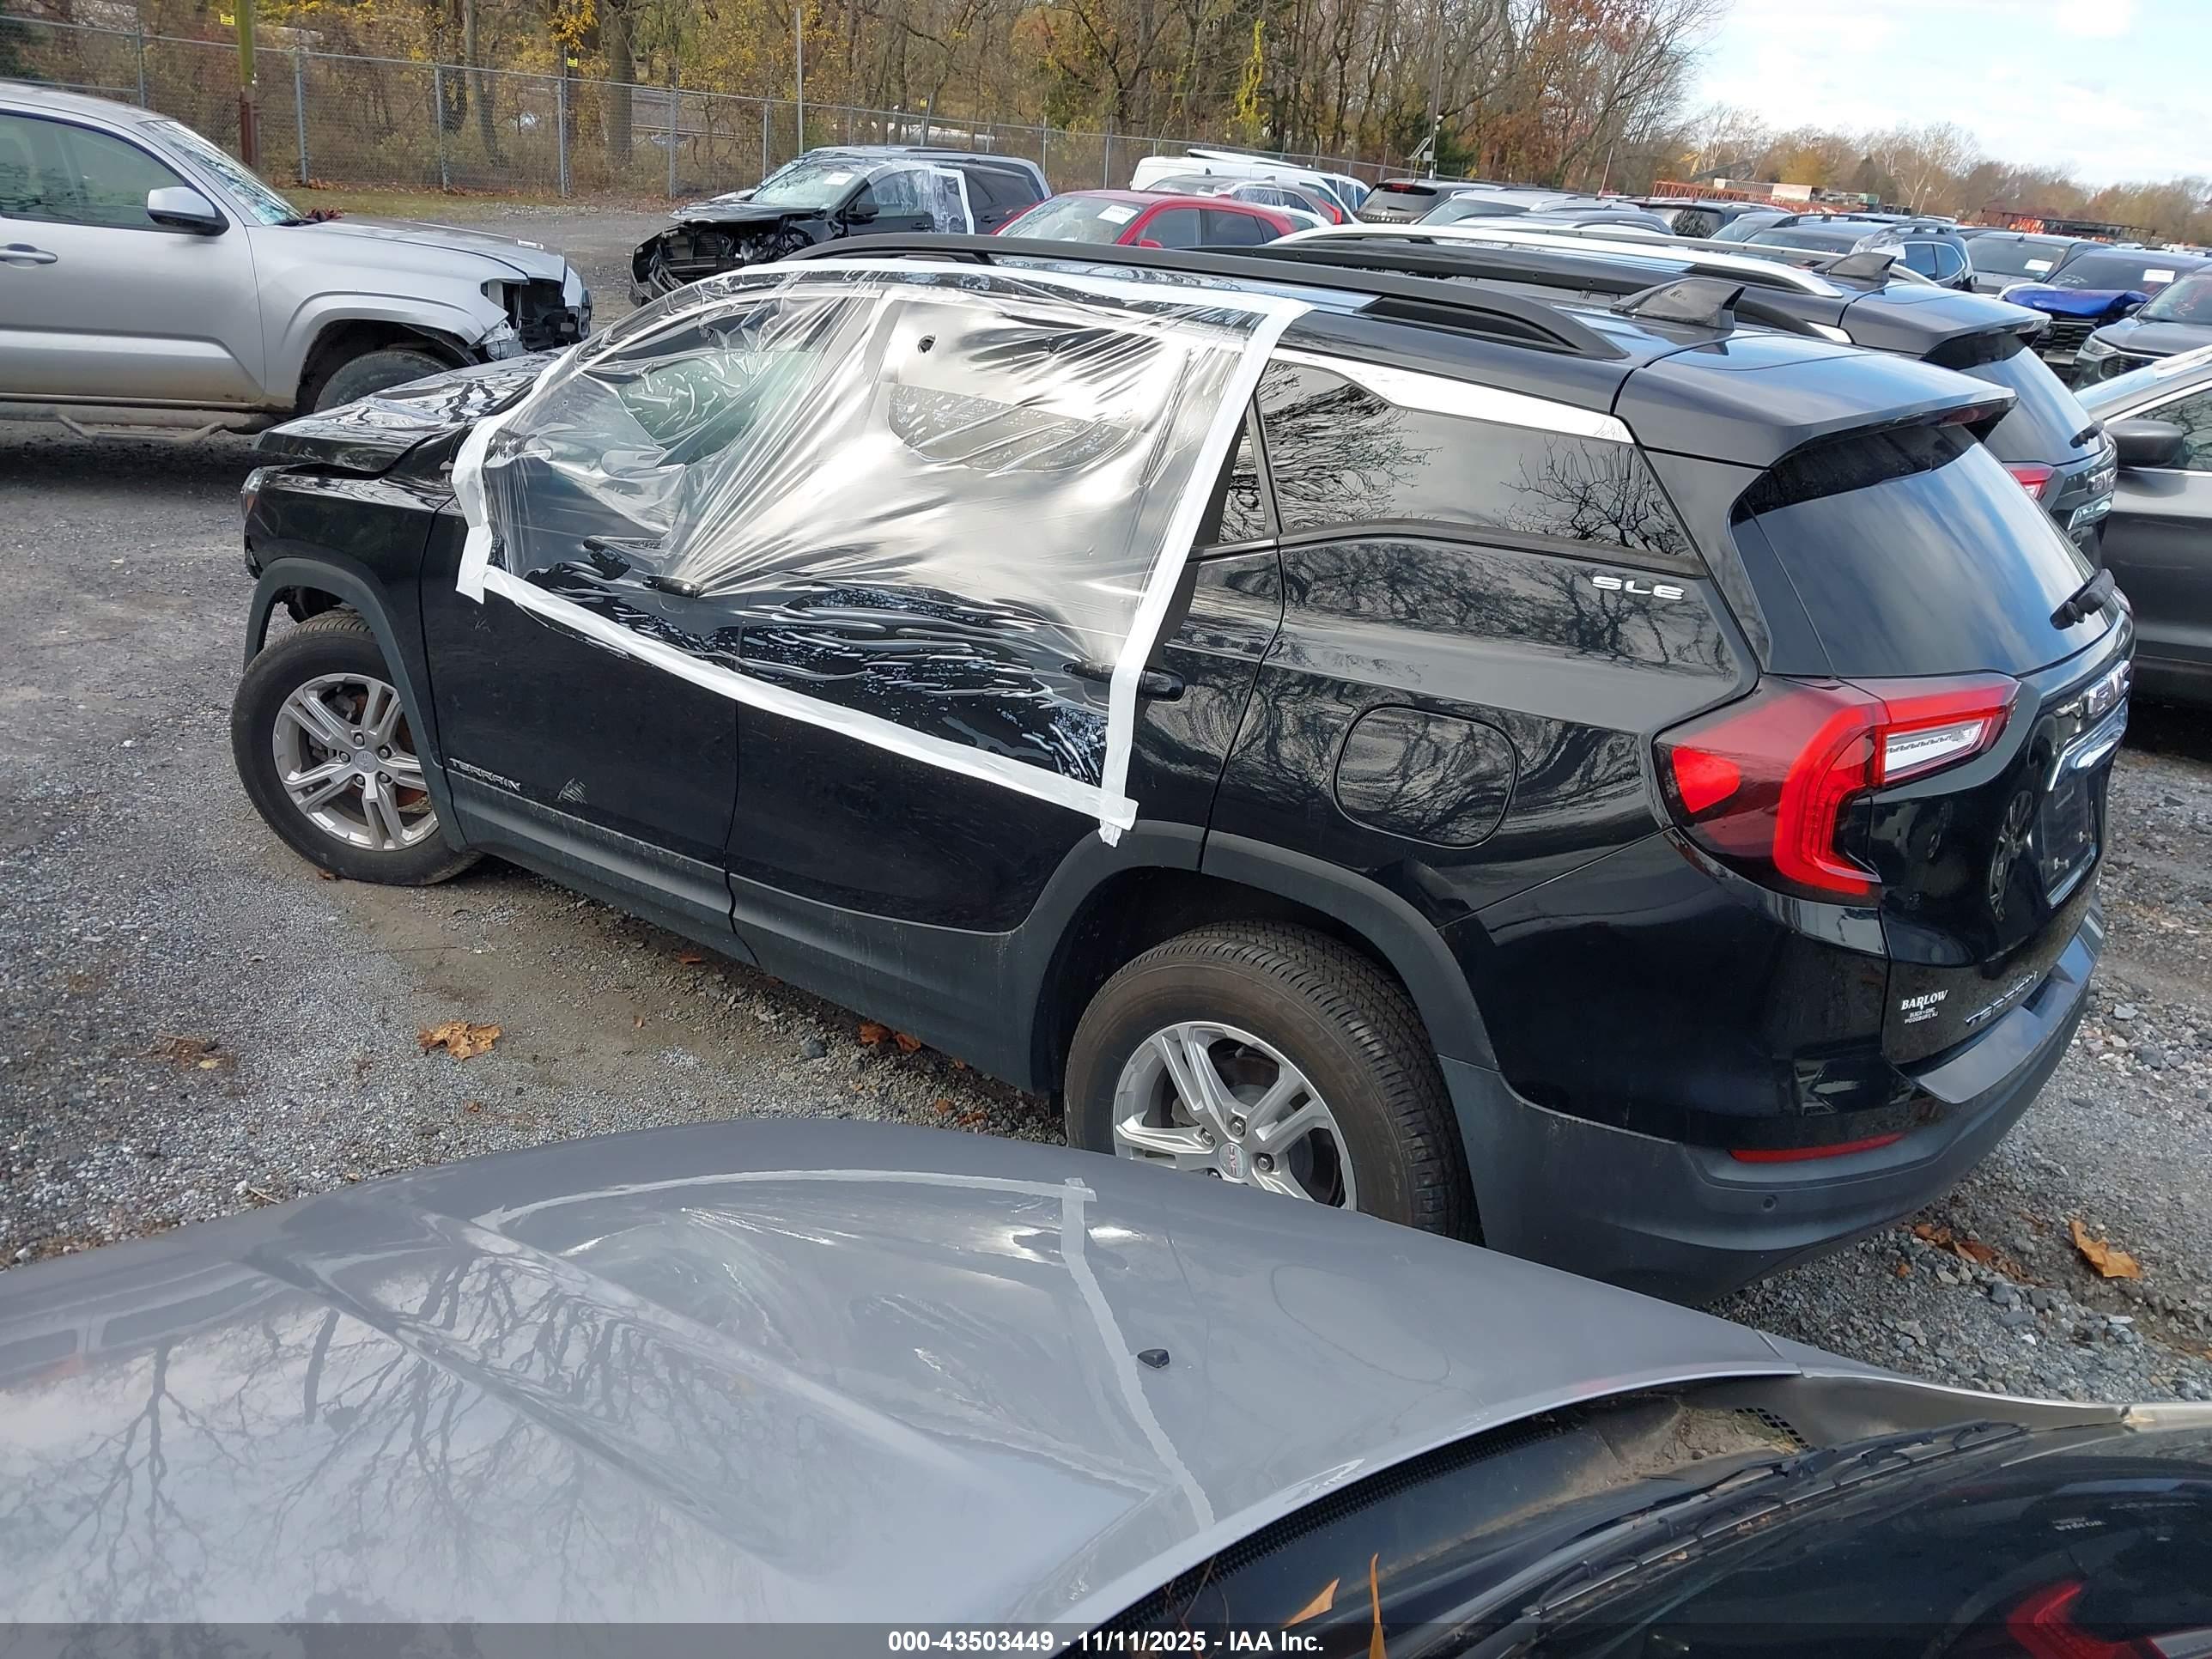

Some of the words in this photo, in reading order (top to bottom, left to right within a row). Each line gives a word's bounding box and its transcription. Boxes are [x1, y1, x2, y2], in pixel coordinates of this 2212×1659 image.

[1592, 575, 1685, 600] SLE
[449, 757, 522, 792] TERRAIN
[1900, 989, 1949, 1011] BARLOW
